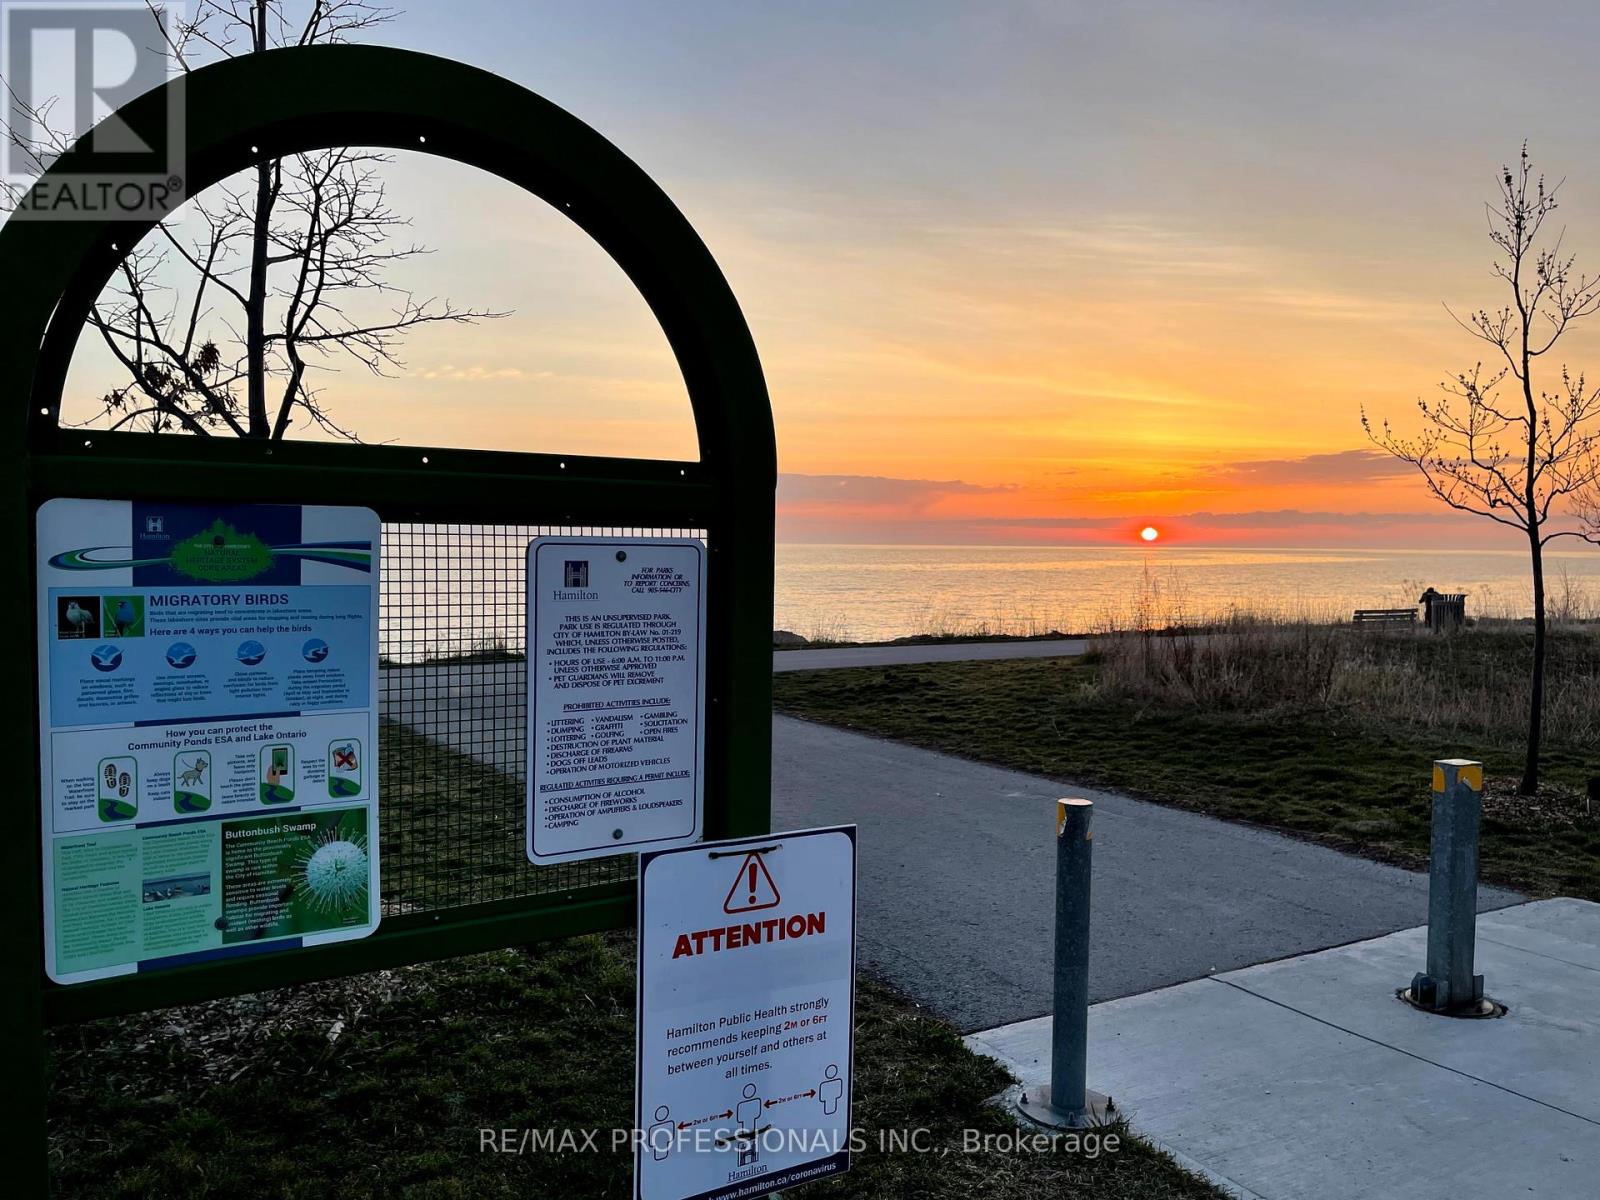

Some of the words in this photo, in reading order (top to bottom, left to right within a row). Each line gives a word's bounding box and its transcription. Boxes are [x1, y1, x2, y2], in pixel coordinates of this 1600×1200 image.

[150, 594, 241, 606] MIGRATORY
[245, 594, 289, 606] BIRDS
[553, 590, 598, 600] Hamilton
[198, 628, 219, 636] ways
[222, 627, 237, 635] you
[564, 702, 604, 710] PROHIBITED
[551, 718, 584, 726] LITTERING
[644, 719, 688, 727] SOLICITATION
[166, 730, 186, 738] How
[226, 725, 256, 735] protect
[551, 726, 584, 734] DUMPING
[595, 731, 624, 739] GOLFING
[128, 739, 181, 750] Community
[184, 737, 212, 745] Ponds
[215, 736, 233, 744] ESA
[235, 734, 251, 742] and
[254, 732, 273, 741] Lake
[276, 731, 307, 739] Ontario
[551, 734, 586, 743] LOITERING
[551, 741, 598, 751] DESTRUCTION
[634, 736, 664, 744] MATERIAL
[551, 750, 589, 759] DISCHARGE
[602, 746, 633, 754] FIREARMS
[550, 766, 587, 775] OPERATION
[600, 761, 639, 771] MOTORIZED
[641, 758, 670, 766] VEHICLES
[540, 782, 573, 791] REGULATED
[575, 779, 605, 788] ACTIVITIES
[607, 776, 637, 785] REQUIRING
[645, 773, 664, 781] PERMIT
[549, 793, 600, 804] CONSUMPTION
[614, 789, 645, 797] ALCOHOL
[549, 803, 587, 813] DISCHARGE
[601, 797, 637, 806] FIREWORKS
[549, 811, 585, 821] OPERATION
[598, 806, 630, 815] AMPLIFIERS
[639, 800, 683, 810] LOUDSPEAKERS
[226, 825, 280, 839] Buttonbush
[283, 823, 316, 834] Swamp
[548, 820, 578, 829] CAMPING
[672, 912, 825, 959] ATTENTION
[667, 1021, 715, 1039] Hamilton
[720, 1013, 751, 1028] Public
[755, 1005, 787, 1021] Health
[790, 997, 829, 1014] strongly
[668, 1033, 737, 1057] recommends
[742, 1024, 782, 1042] keeping
[801, 1019, 809, 1027] or
[668, 1057, 713, 1075] between
[717, 1045, 758, 1066] yourself
[761, 1038, 779, 1053] and
[783, 1034, 813, 1049] others
[817, 1031, 826, 1041] at
[725, 1067, 737, 1079] all
[741, 1062, 772, 1075] times.
[728, 1164, 767, 1182] Hamilton
[715, 1162, 837, 1200] www.hamilton.ca/coronavirus
